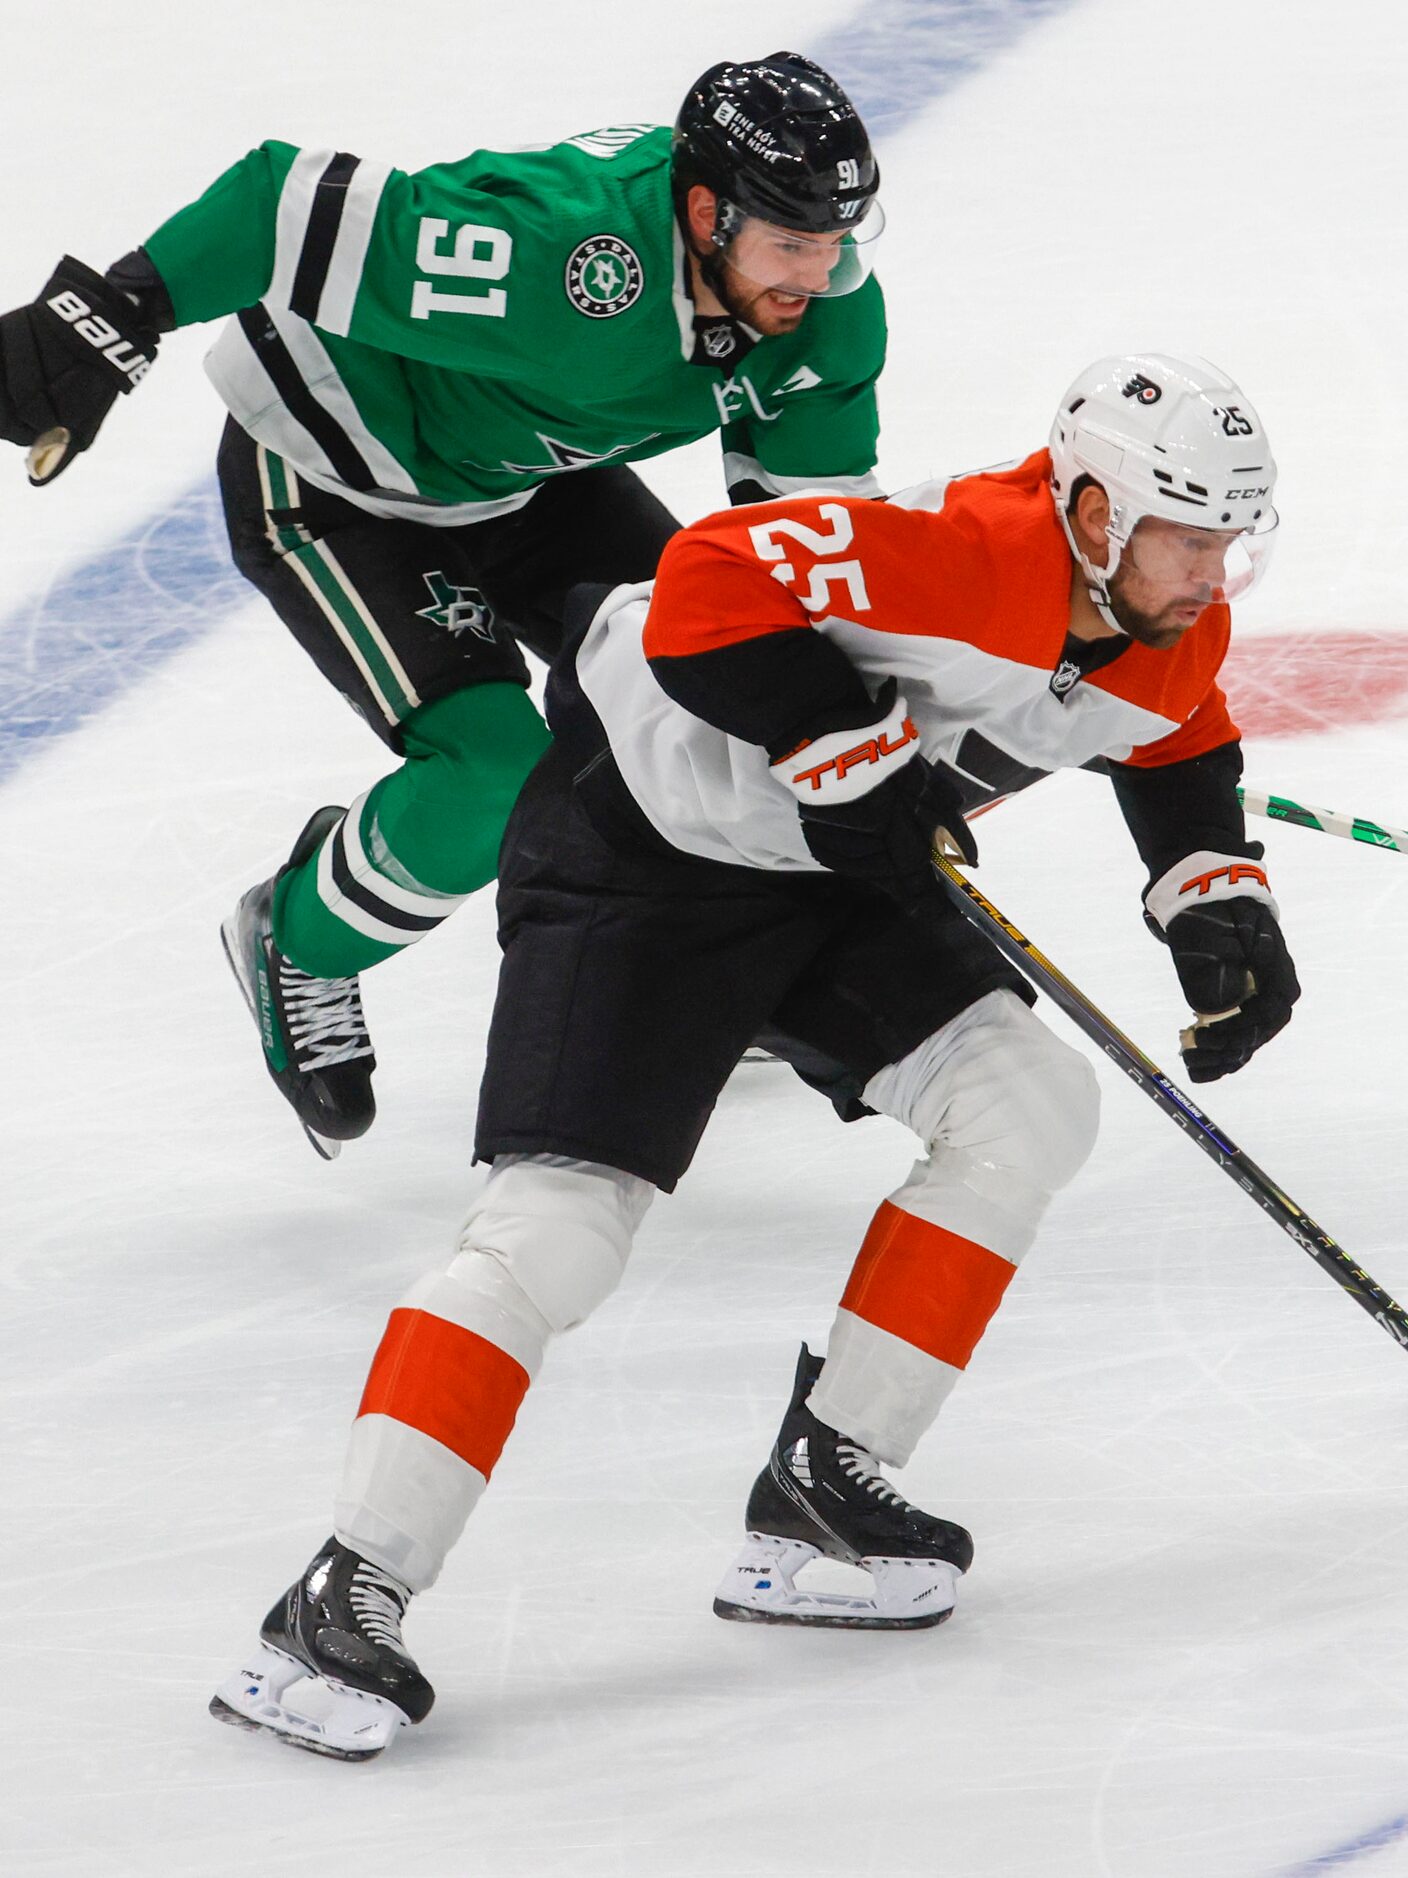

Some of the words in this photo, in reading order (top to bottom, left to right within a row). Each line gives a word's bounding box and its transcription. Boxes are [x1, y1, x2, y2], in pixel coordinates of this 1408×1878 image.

[836, 158, 860, 190] 91
[410, 216, 513, 321] 91
[1213, 405, 1254, 437] 25
[1223, 486, 1270, 501] CCM
[748, 503, 872, 613] 25
[967, 887, 1026, 942] TRUE
[737, 1566, 772, 1575] TRUE
[240, 1669, 265, 1682] TRUE
